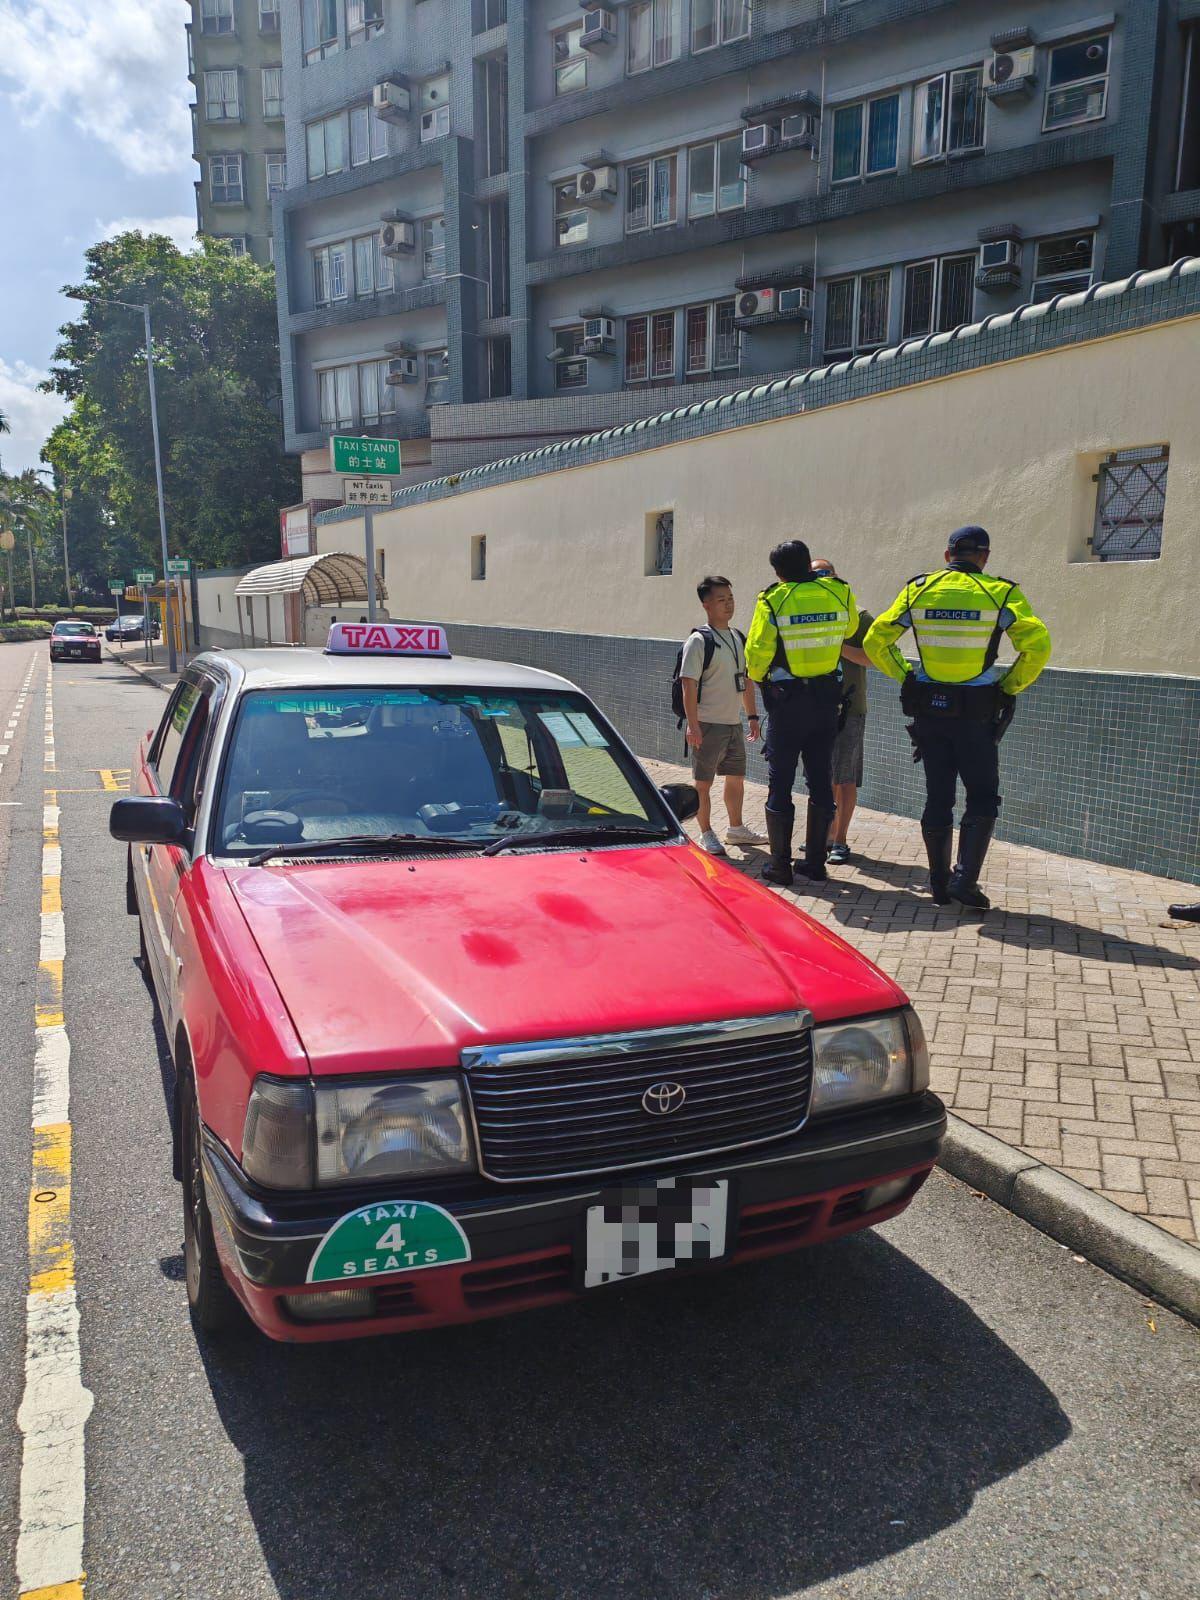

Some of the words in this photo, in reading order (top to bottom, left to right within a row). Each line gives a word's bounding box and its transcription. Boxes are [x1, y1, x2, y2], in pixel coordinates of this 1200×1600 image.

[337, 441, 359, 451] TAXI
[361, 443, 396, 453] STAND
[348, 456, 387, 469] 的士站
[349, 493, 388, 502] 新界的士
[800, 614, 828, 623] POLICE
[935, 610, 968, 619] POLICE
[341, 626, 440, 650] TAXI
[357, 1204, 418, 1226] TAXI
[375, 1223, 406, 1252] 4
[342, 1249, 438, 1275] SEATS
